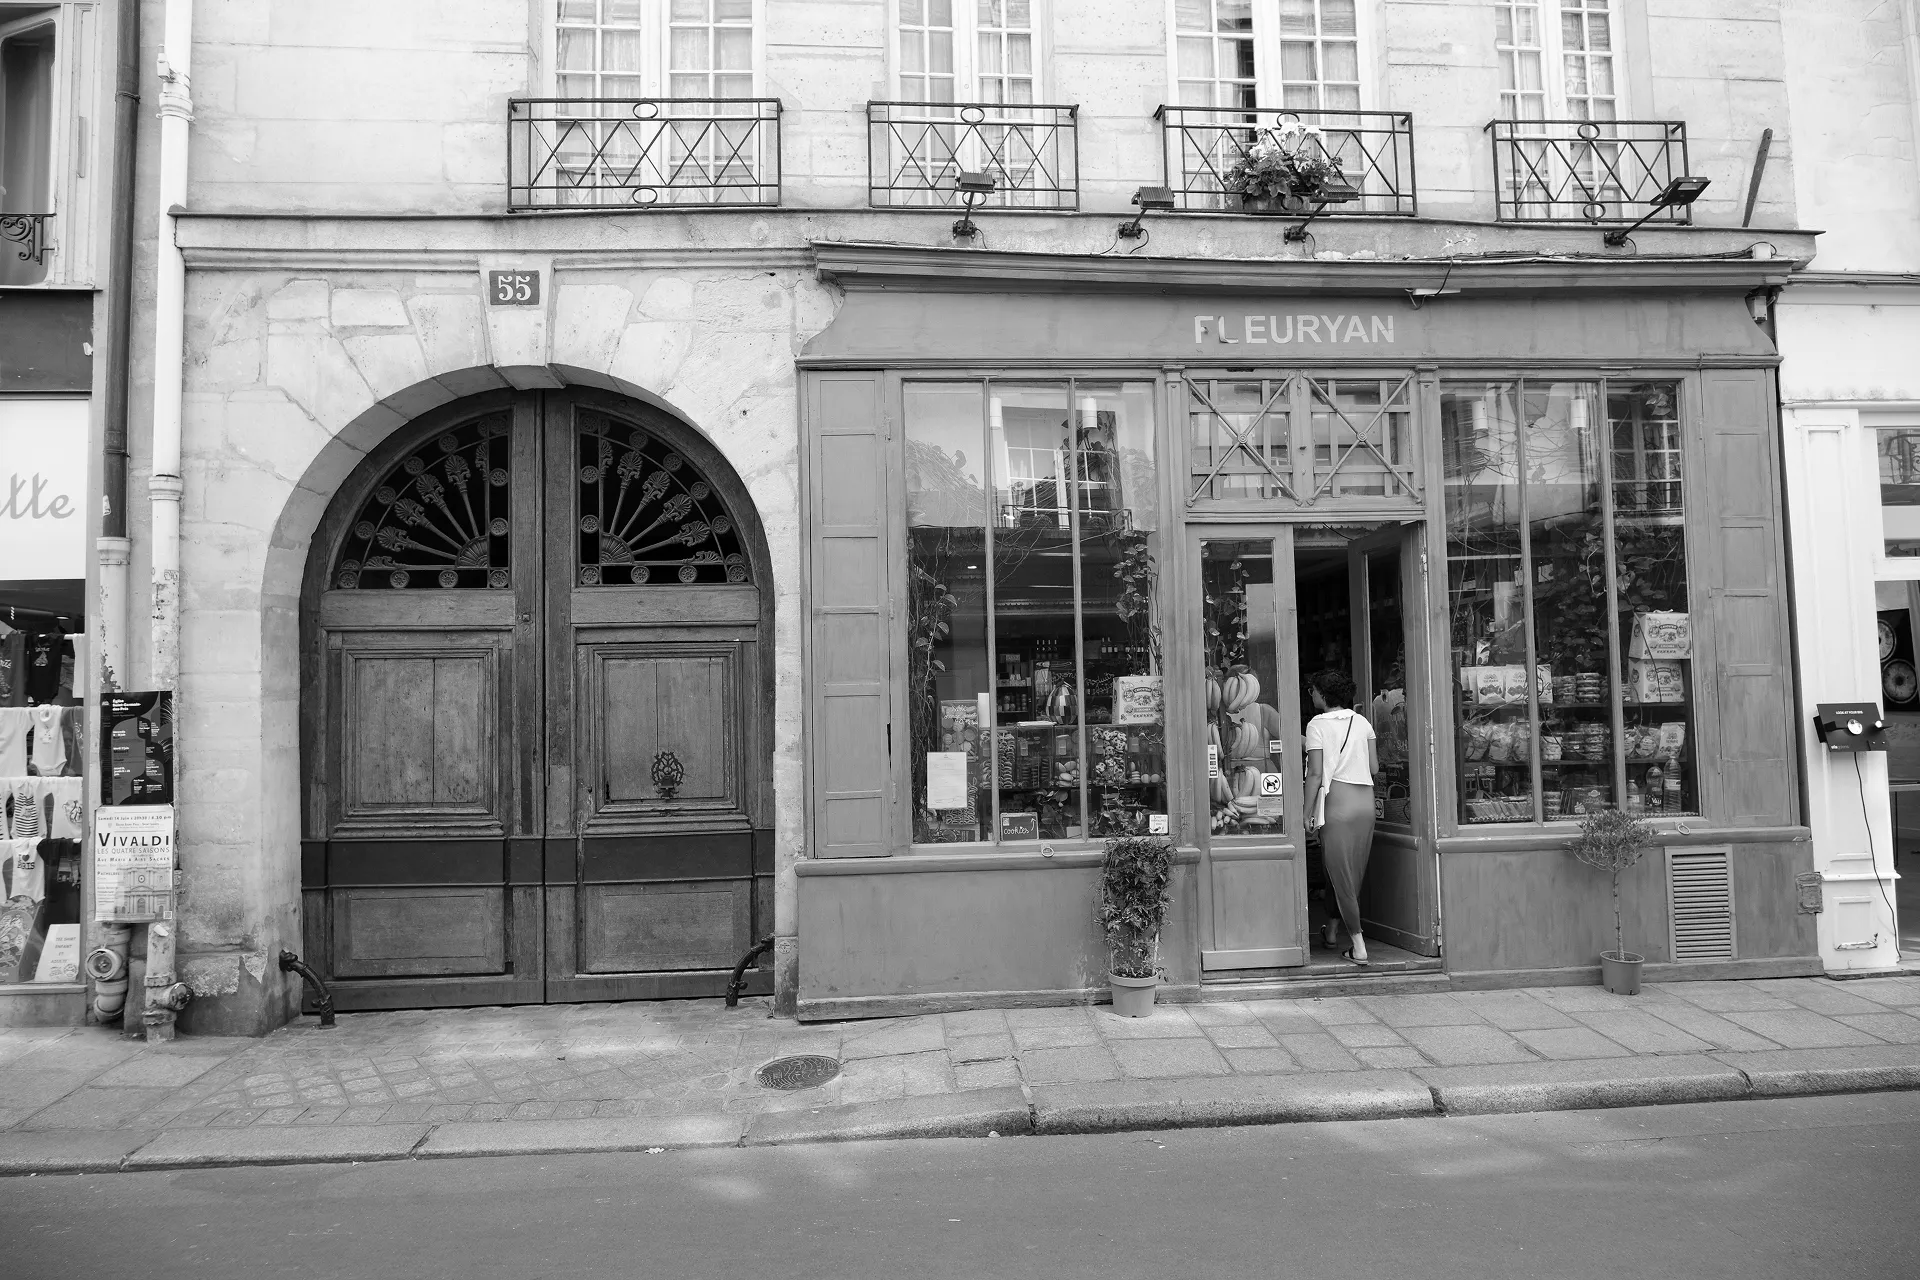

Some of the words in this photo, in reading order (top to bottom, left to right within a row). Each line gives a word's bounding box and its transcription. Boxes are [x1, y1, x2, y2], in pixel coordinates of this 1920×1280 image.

[498, 275, 531, 300] 55
[1194, 315, 1395, 344] FLEURYAN
[0, 472, 75, 519] tte
[98, 832, 169, 846] VIVALDI
[111, 847, 136, 855] QUATRE
[138, 846, 170, 854] SAISONS
